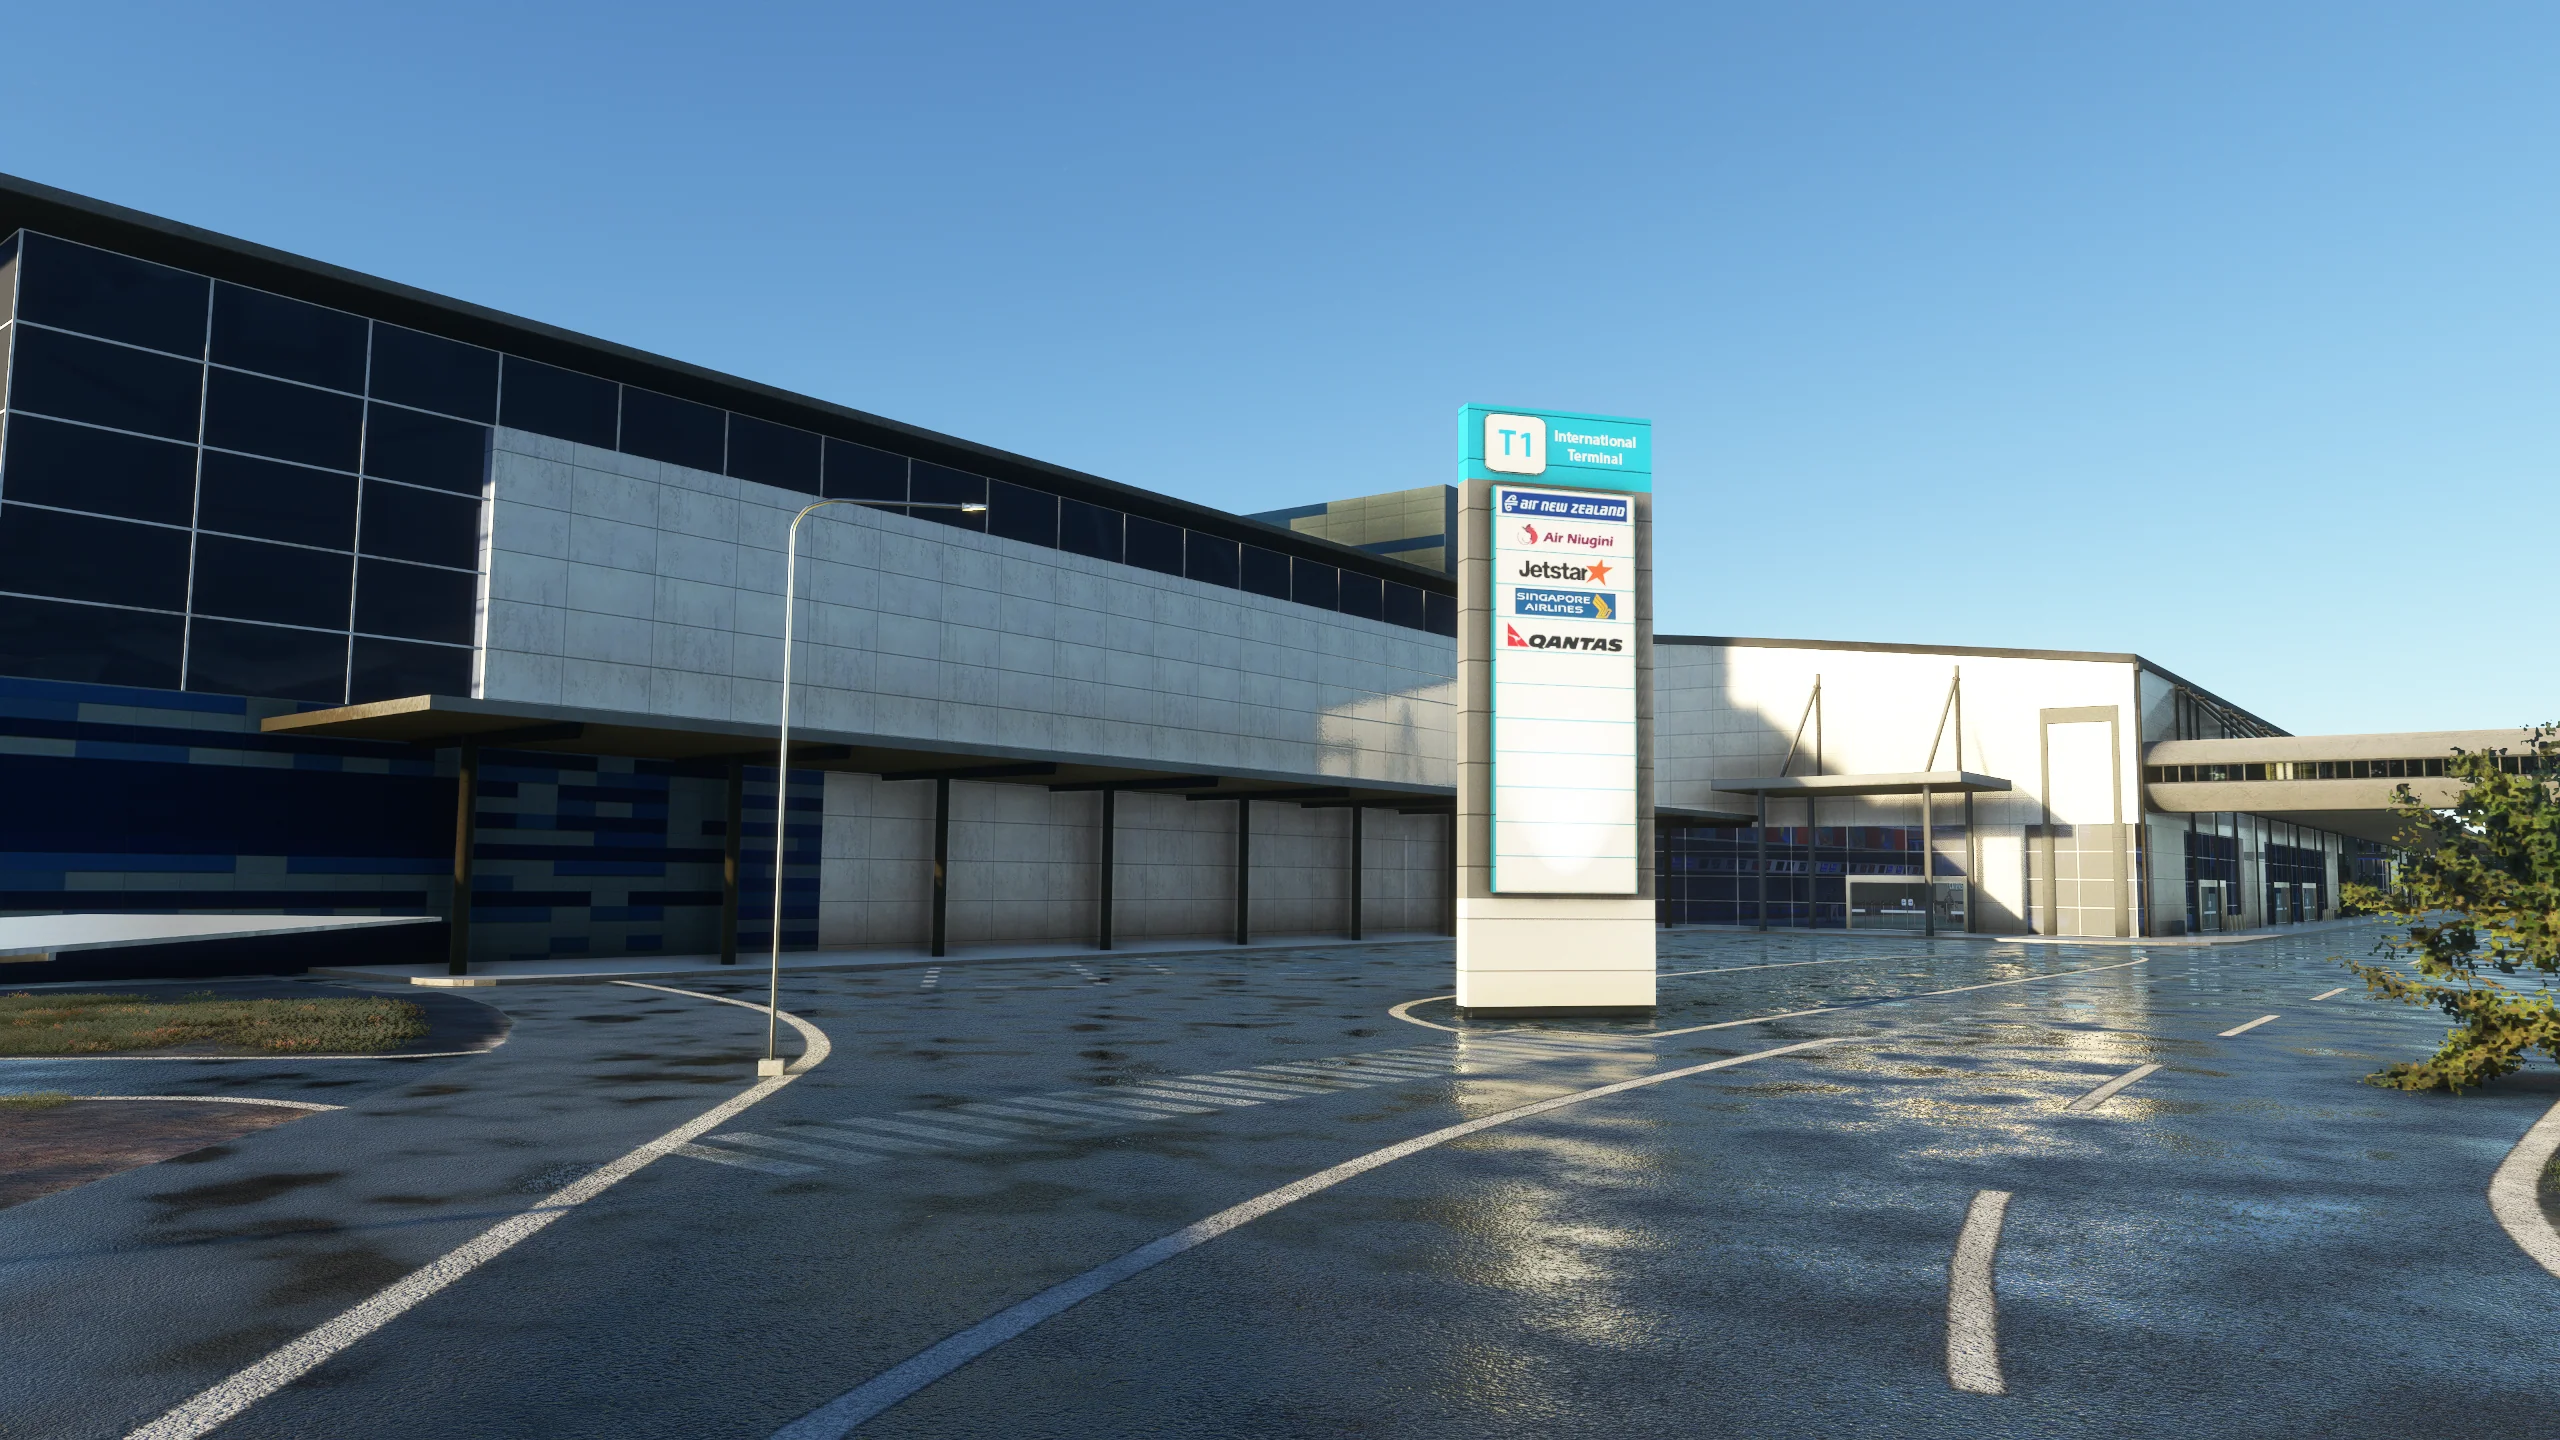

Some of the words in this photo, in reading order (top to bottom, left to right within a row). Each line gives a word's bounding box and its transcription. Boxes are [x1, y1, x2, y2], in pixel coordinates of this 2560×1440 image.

[1498, 428, 1531, 457] T1
[1554, 429, 1637, 449] International
[1567, 448, 1623, 465] Terminal
[1543, 532, 1564, 543] Air
[1567, 533, 1613, 548] Niugini
[1519, 560, 1588, 580] Jetstar
[1516, 592, 1591, 605] SINGAPORE
[1524, 603, 1584, 614] AIRLINES
[1528, 634, 1623, 652] QANTAS
